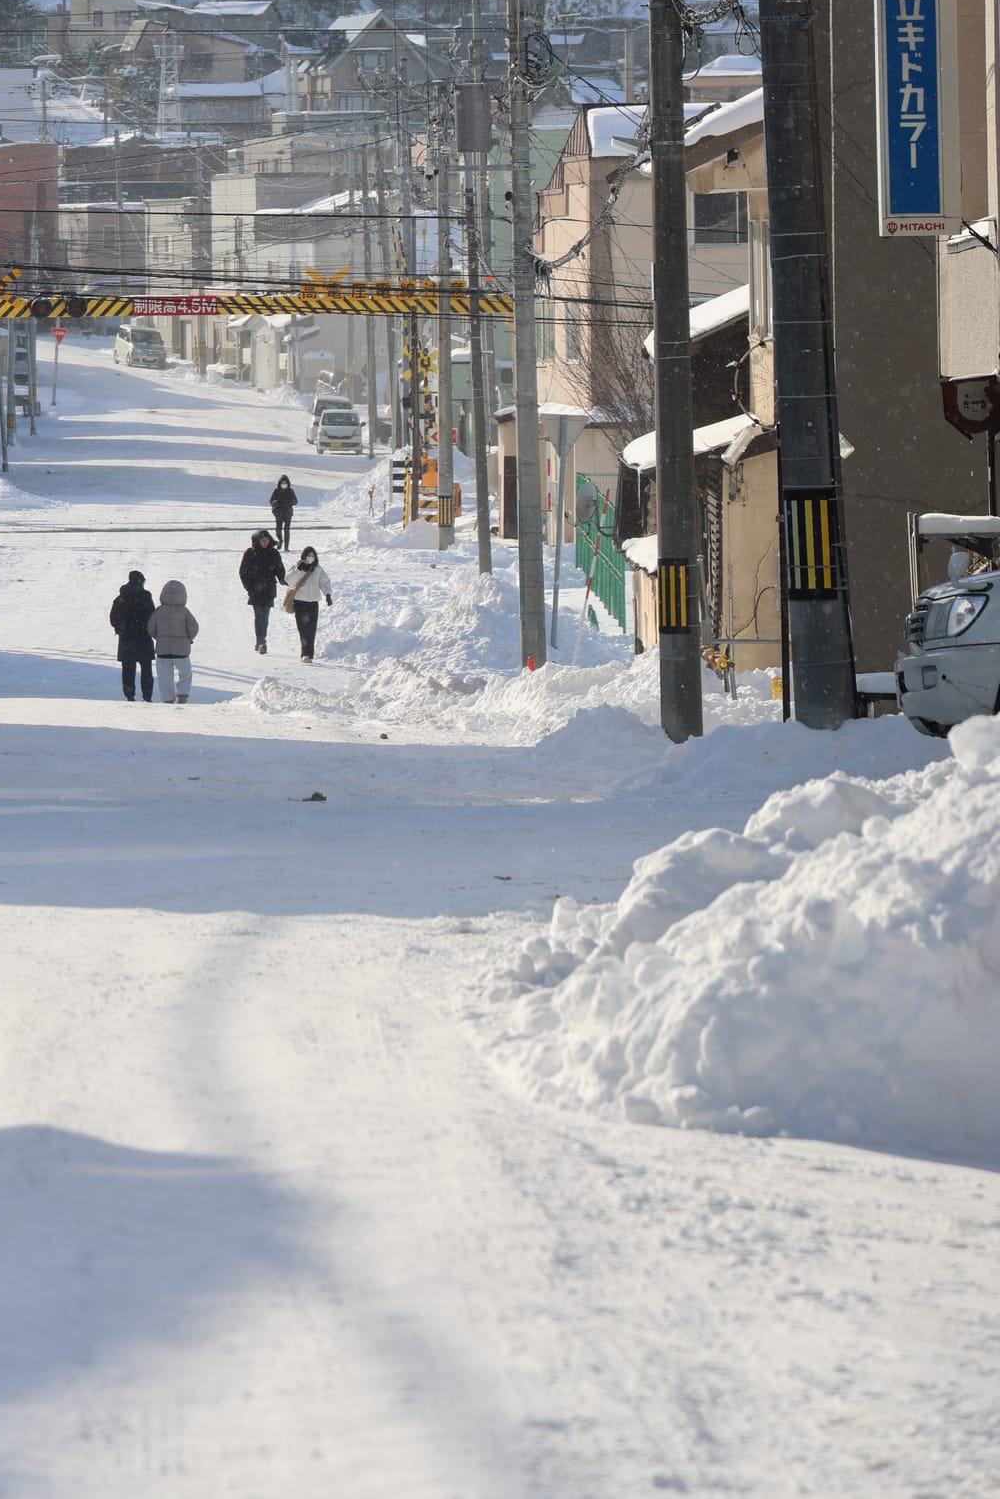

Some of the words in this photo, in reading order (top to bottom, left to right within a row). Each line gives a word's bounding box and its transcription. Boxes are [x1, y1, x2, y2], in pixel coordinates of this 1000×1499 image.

[900, 223, 945, 231] HITACHI
[134, 298, 217, 314] 制限高4.5M
